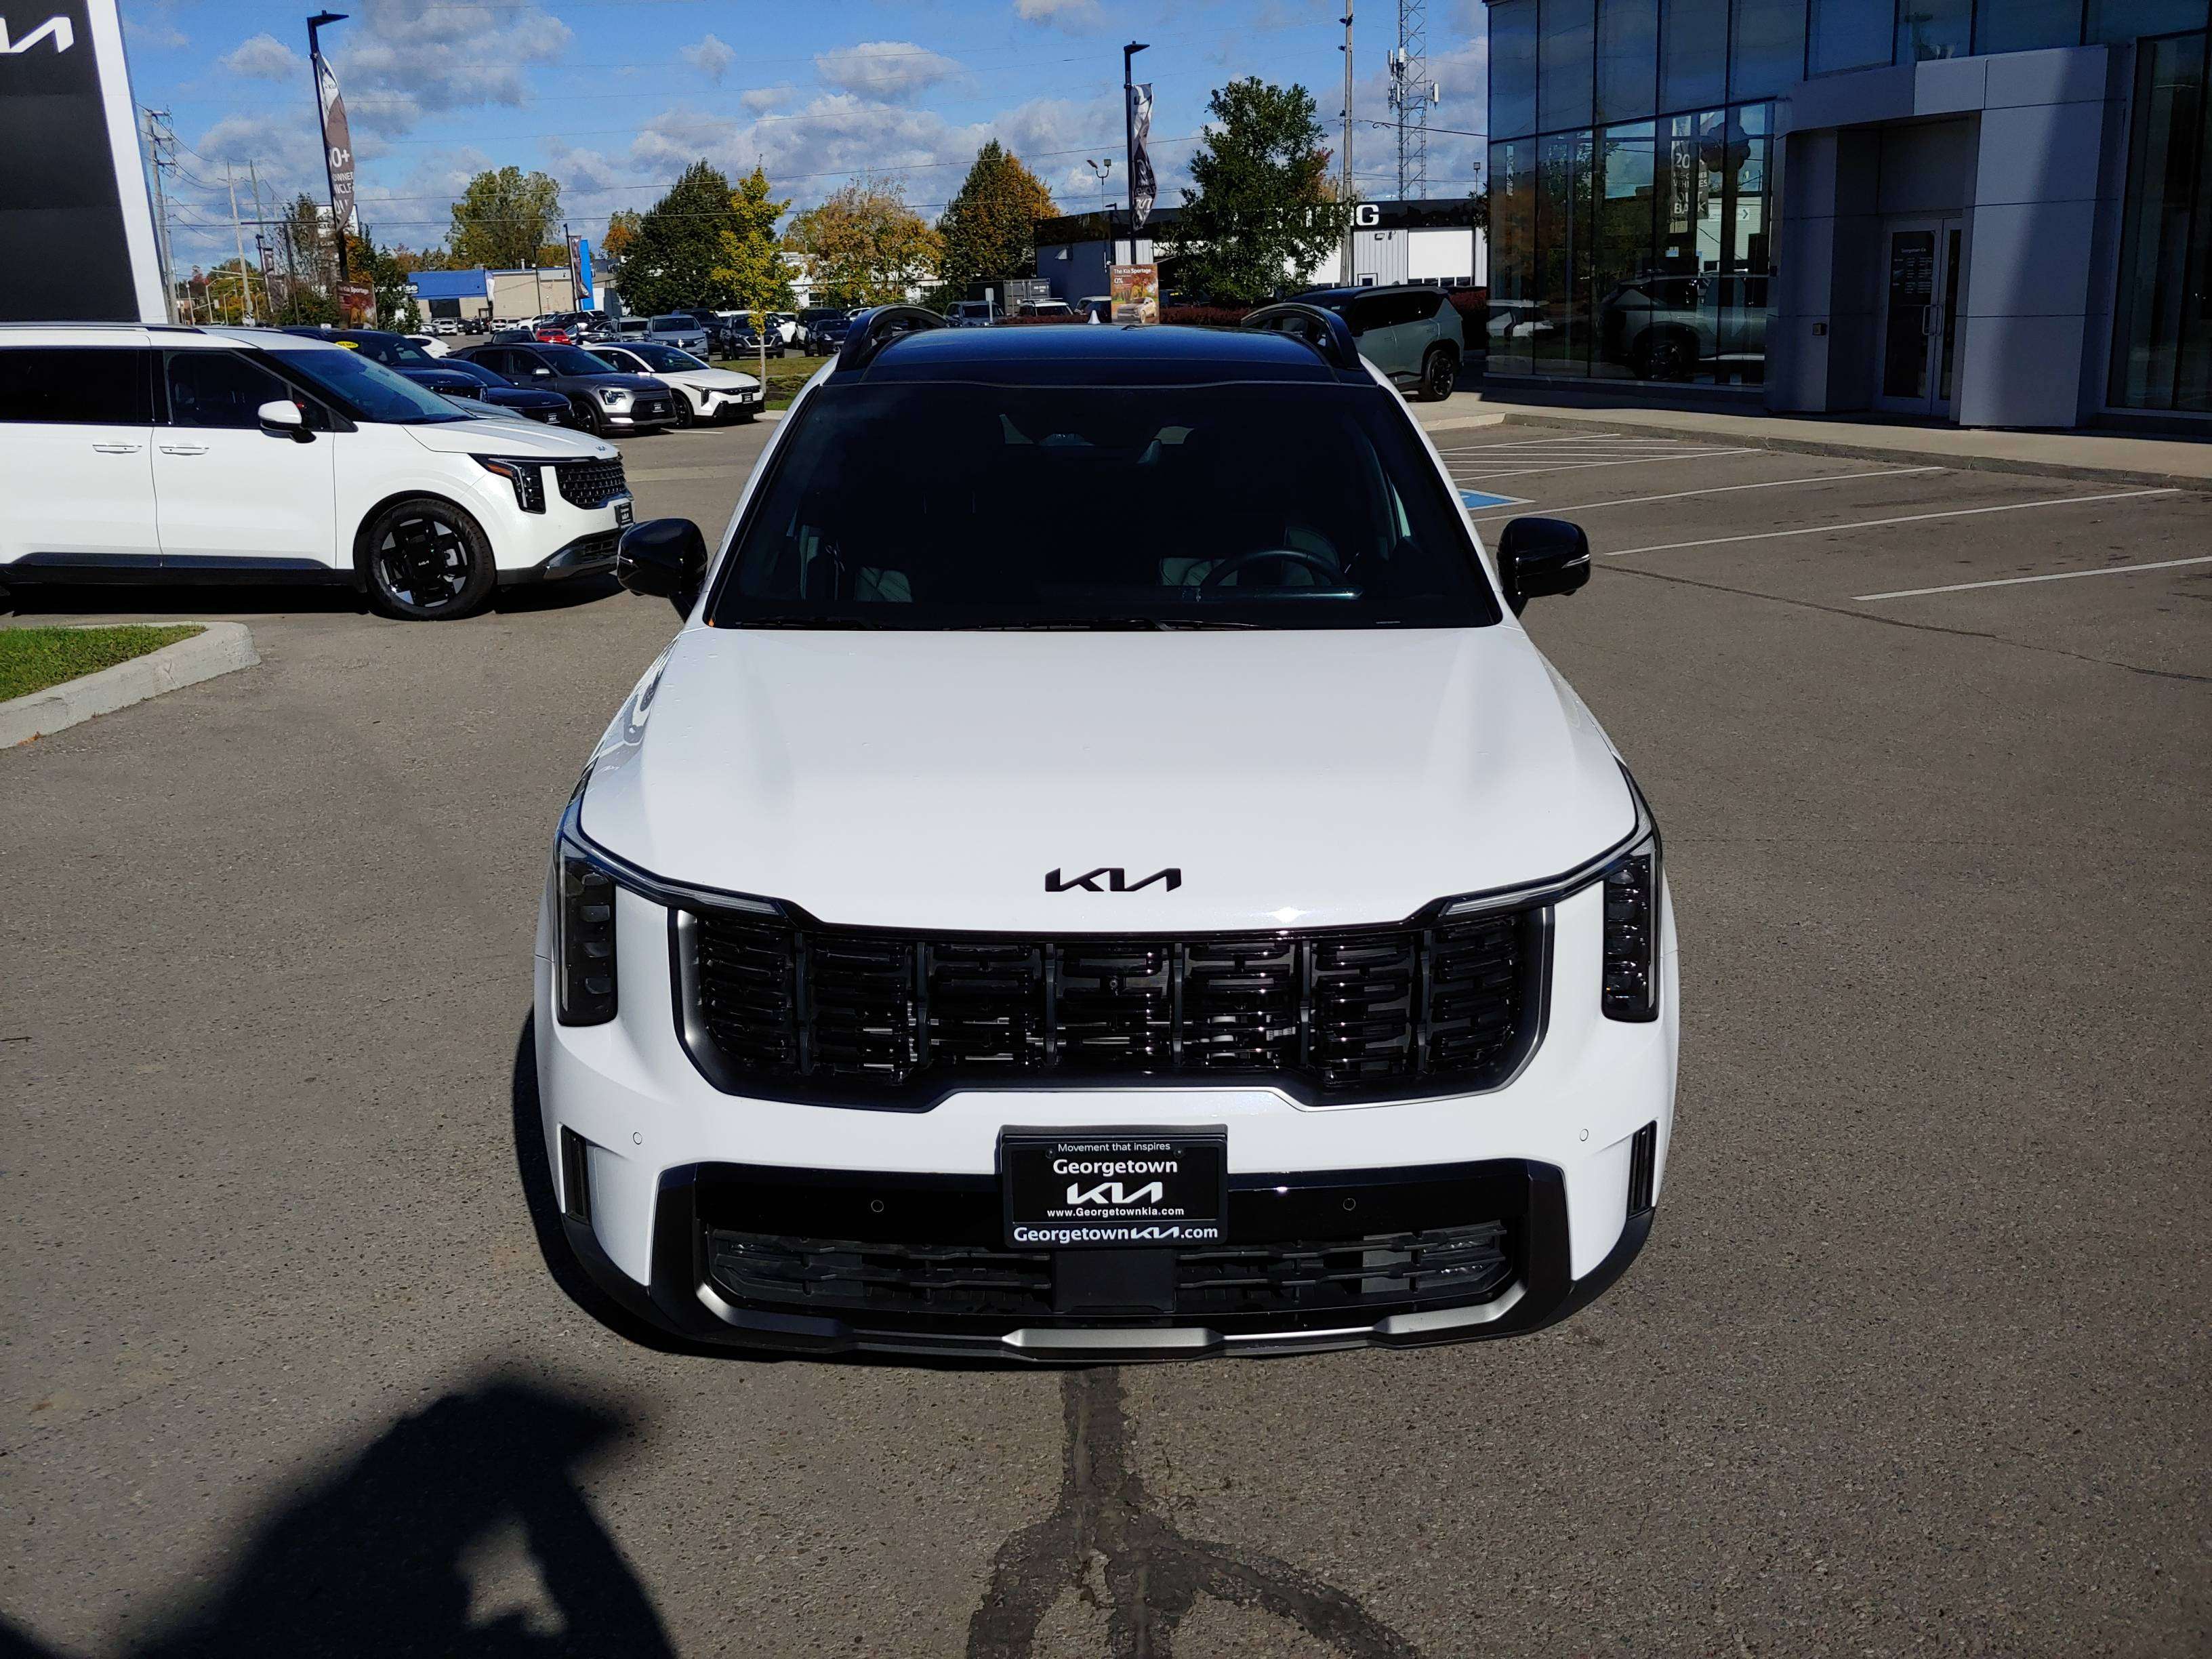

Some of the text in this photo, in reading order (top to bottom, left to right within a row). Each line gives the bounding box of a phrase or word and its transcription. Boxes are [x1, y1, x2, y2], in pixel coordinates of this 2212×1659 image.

[1045, 867, 1181, 892] KIA
[1058, 1142, 1170, 1152] Movement that inspires
[1052, 1159, 1178, 1176] Georgetown
[1067, 1182, 1163, 1204] KIA
[1047, 1207, 1185, 1217] www.Georgetownkia.com
